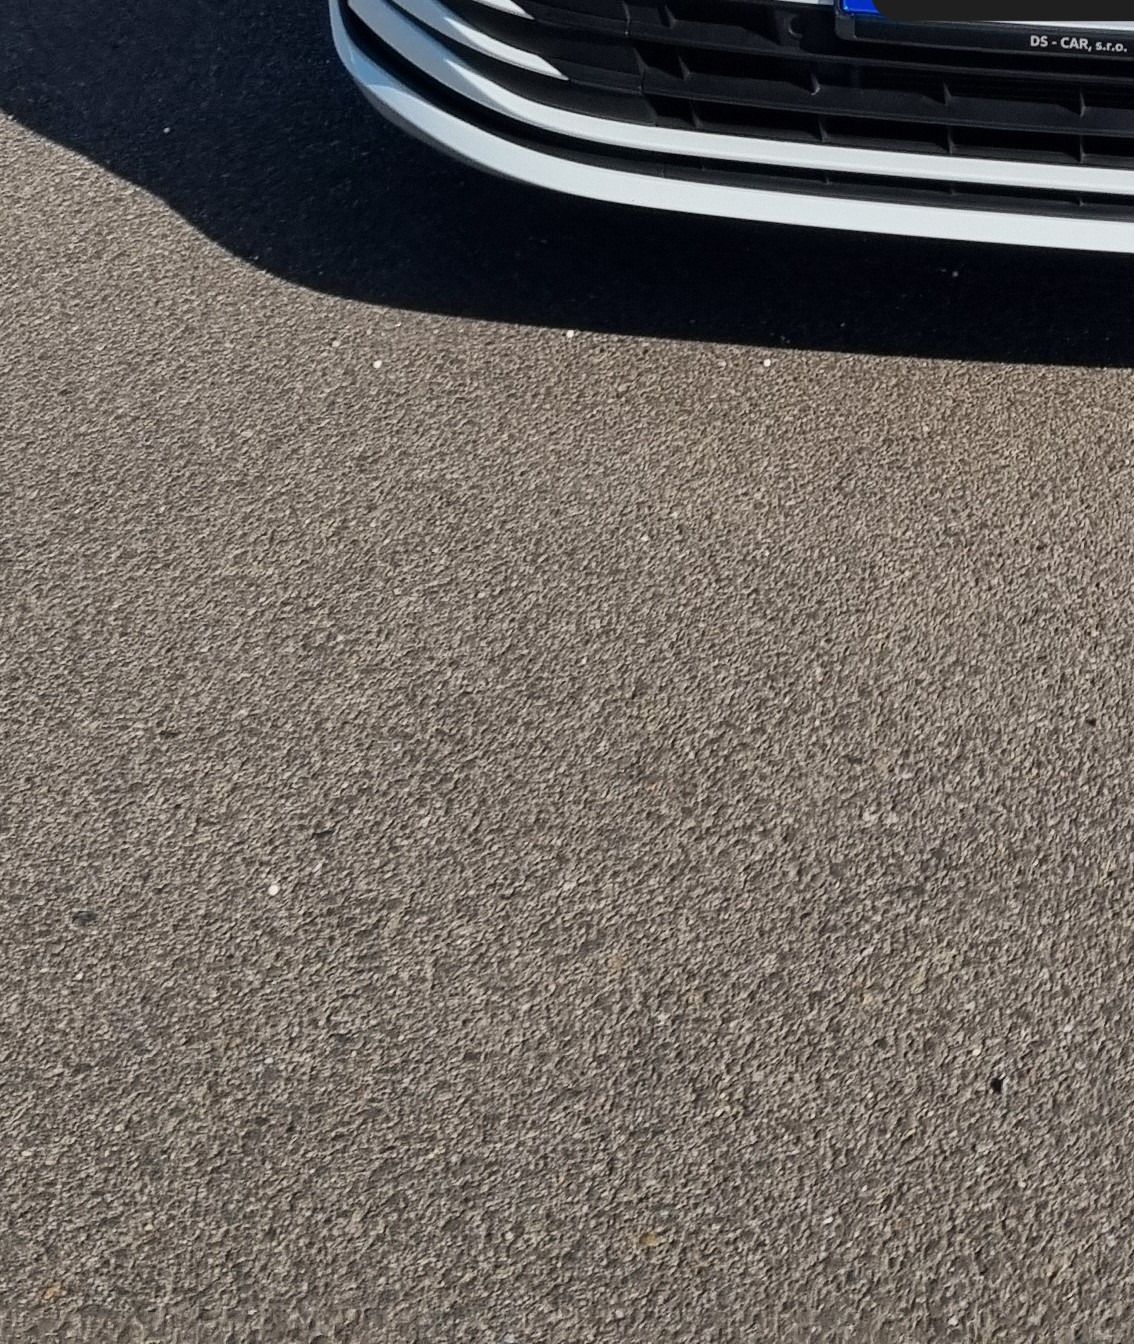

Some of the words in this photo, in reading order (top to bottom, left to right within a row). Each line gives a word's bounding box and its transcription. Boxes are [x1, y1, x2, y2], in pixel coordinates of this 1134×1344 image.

[1030, 35, 1049, 47] DS
[1060, 36, 1092, 52] CAR,
[1095, 41, 1128, 53] s.r.o.
